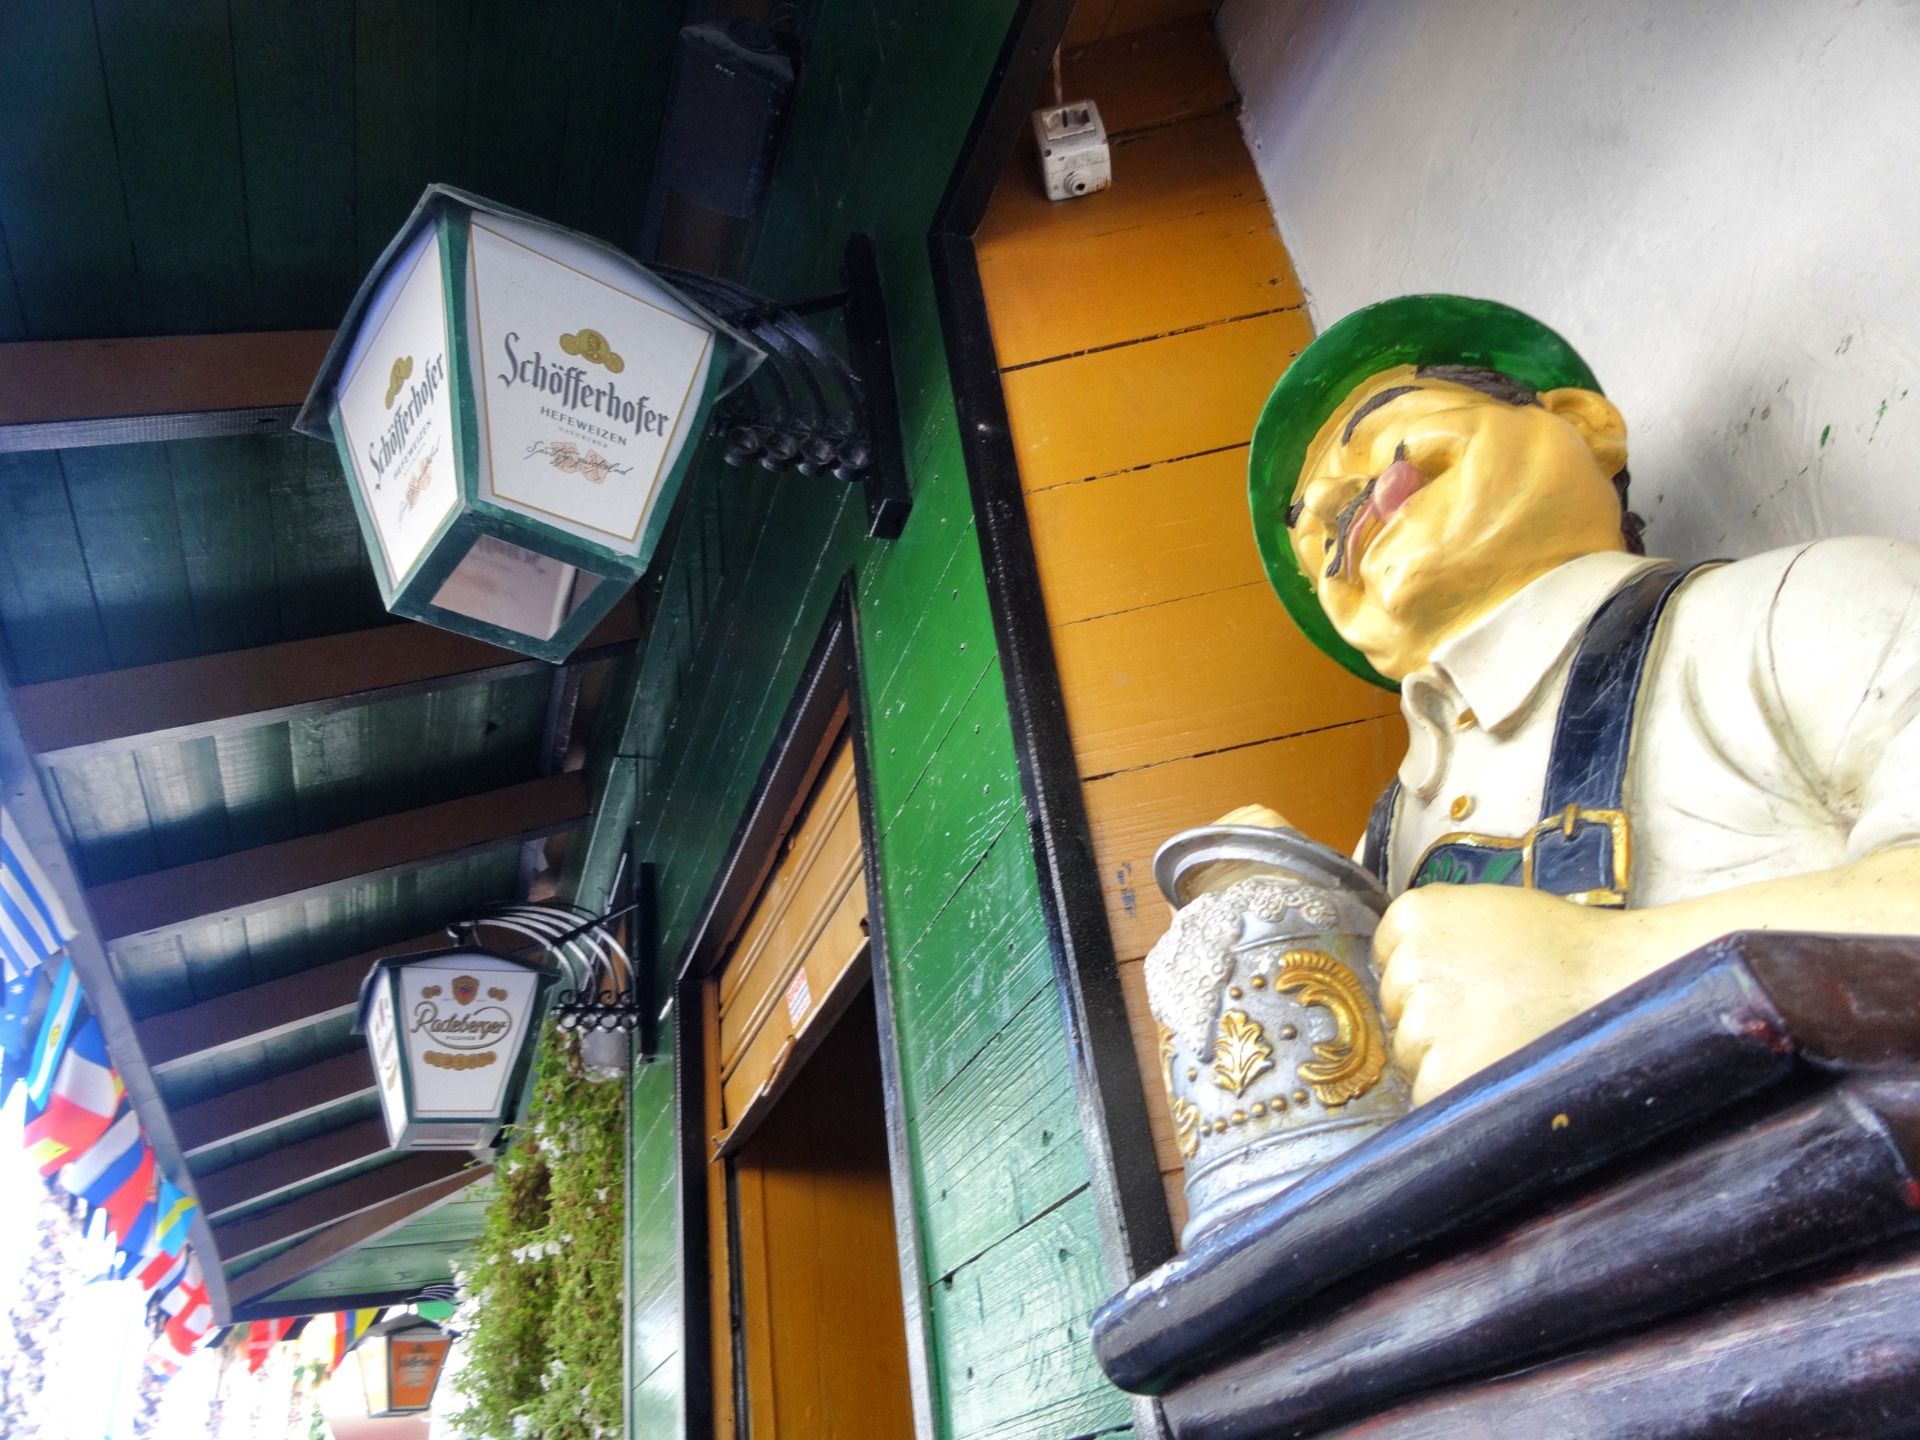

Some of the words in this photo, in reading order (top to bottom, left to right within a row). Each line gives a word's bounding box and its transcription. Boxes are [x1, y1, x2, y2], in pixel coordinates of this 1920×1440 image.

[498, 331, 669, 437] Schöfferhofer
[368, 353, 444, 492] Schöfferhofer
[540, 405, 627, 446] HEFEWEIZEN
[411, 1001, 510, 1044] Radeberger
